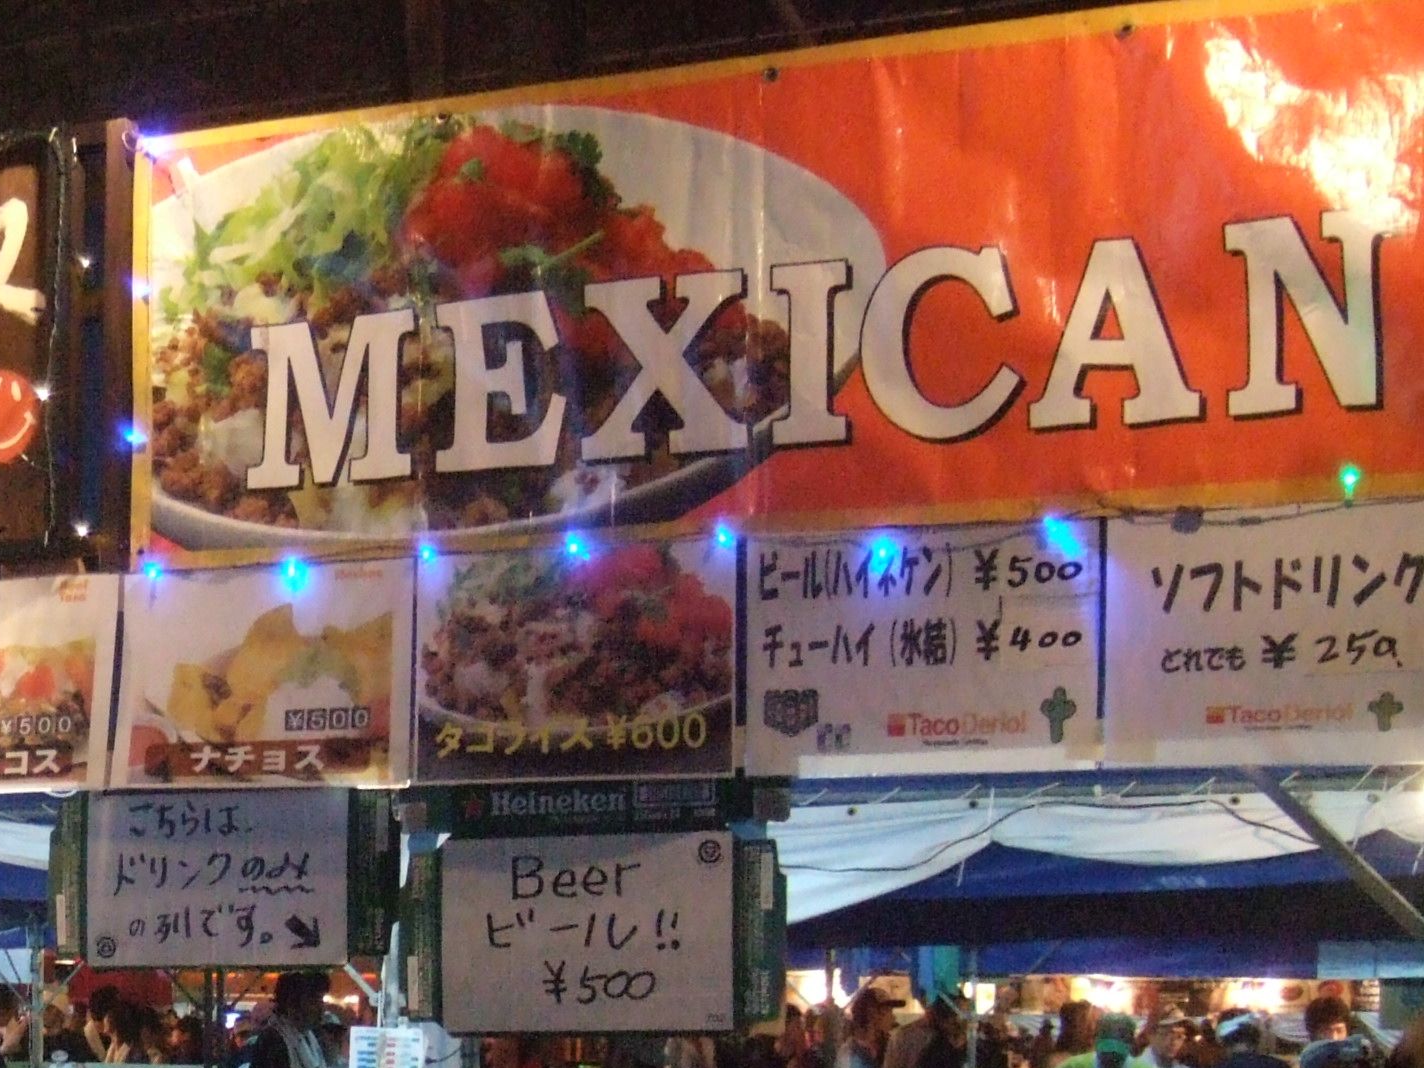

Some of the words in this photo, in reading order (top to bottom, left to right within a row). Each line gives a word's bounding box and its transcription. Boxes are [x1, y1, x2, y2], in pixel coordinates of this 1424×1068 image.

[248, 209, 1398, 490] MEXICAN
[975, 547, 1083, 591] ¥500
[1151, 552, 1424, 612] ソフトドリンク
[976, 615, 1083, 661] ¥400
[0, 715, 72, 735] ¥500
[286, 707, 370, 730] ¥500
[436, 714, 593, 758] タコライス
[607, 712, 706, 750] ¥600
[189, 745, 325, 773] ナチョス
[487, 789, 628, 818] Heineken
[114, 851, 310, 896] ドリンクのみ
[512, 856, 641, 900] Beer
[128, 904, 274, 948] の列です。
[543, 960, 657, 1005] ¥500
